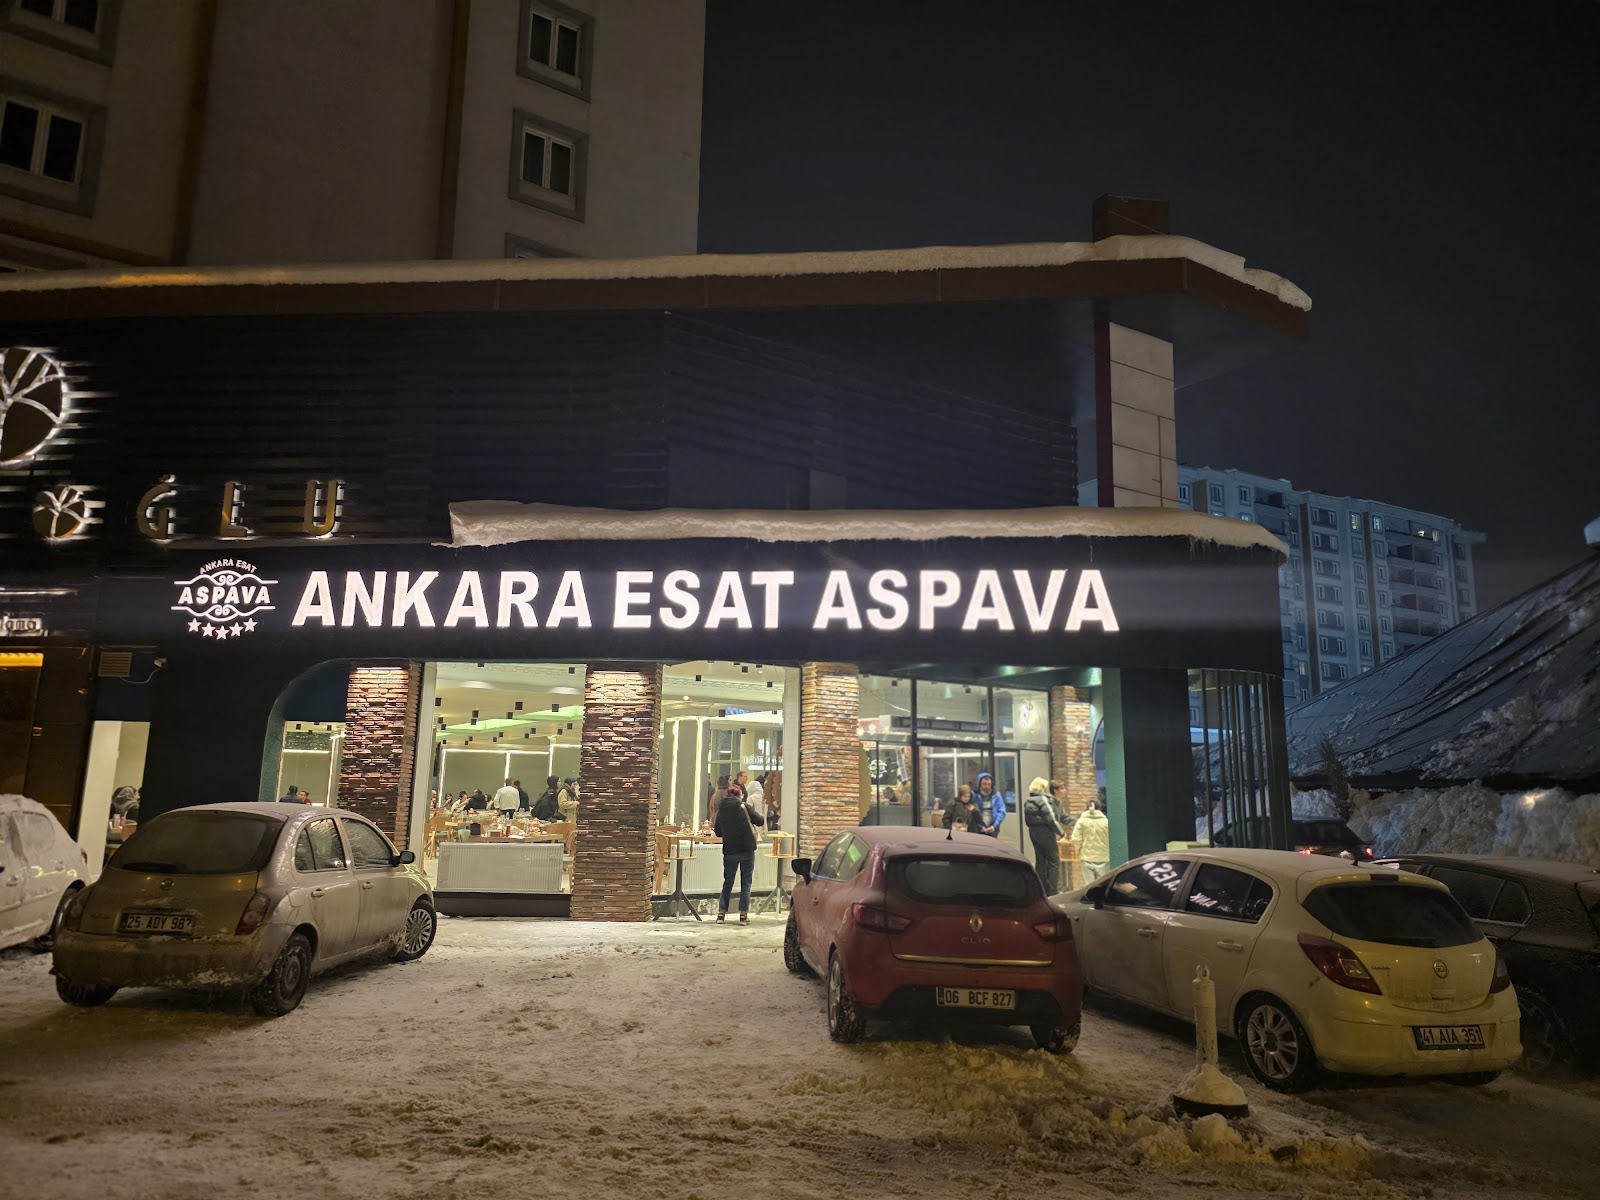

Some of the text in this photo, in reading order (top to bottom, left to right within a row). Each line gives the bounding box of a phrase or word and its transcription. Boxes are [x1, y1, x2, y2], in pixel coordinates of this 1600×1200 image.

[200, 559, 257, 575] ANKARA ESAT
[178, 586, 271, 604] ASPAVA
[292, 569, 1120, 631] ANKARA ESAT ASPAVA
[126, 916, 141, 929] 25
[146, 916, 168, 929] ADY
[945, 990, 1012, 1007] 06 BCF 827
[1423, 1028, 1482, 1044] 41 AIA 351
